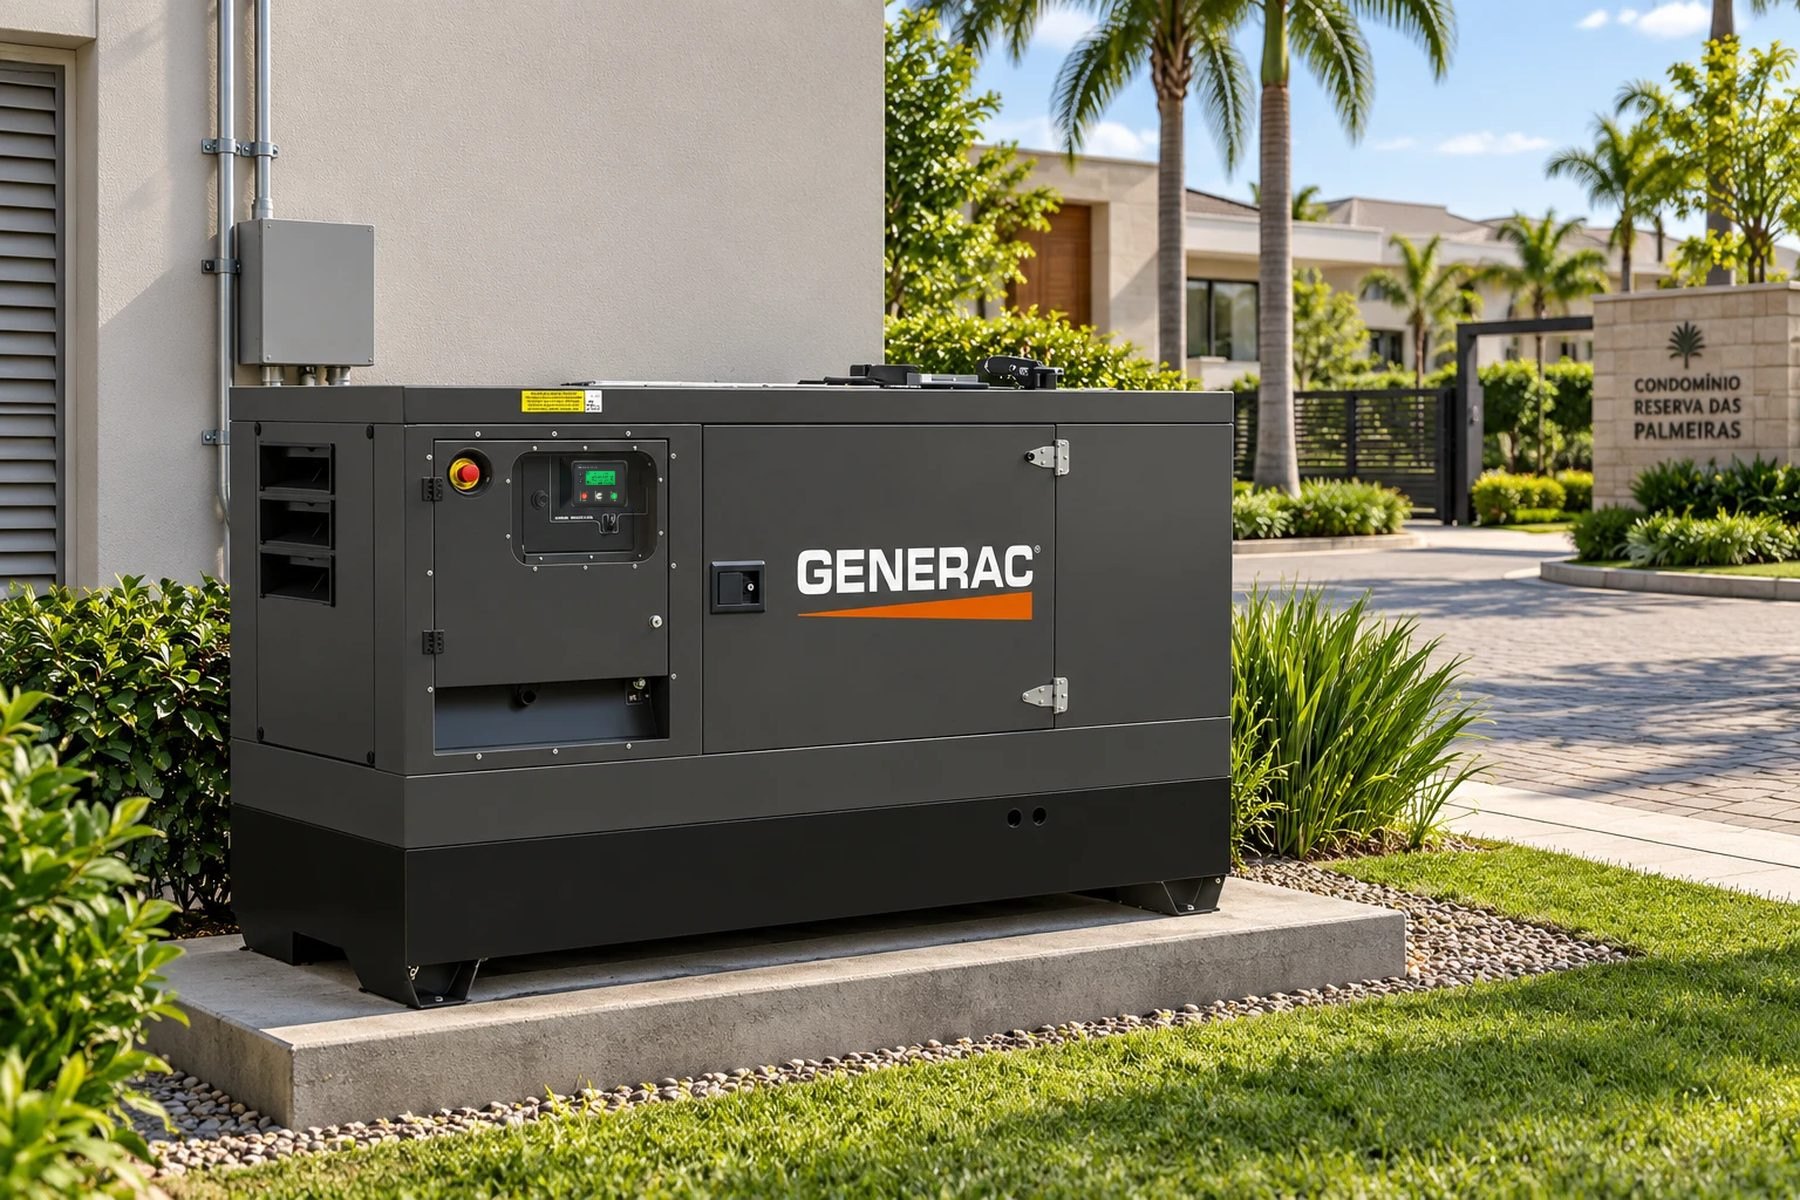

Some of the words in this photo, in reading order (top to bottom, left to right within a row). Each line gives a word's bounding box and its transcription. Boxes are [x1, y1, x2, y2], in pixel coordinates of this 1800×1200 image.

[1634, 373, 1741, 393] CONDOMÍNIO
[1634, 398, 1703, 415] RESERVA
[1709, 398, 1742, 414] DAS
[1634, 421, 1742, 440] PALMEIRAS
[797, 545, 1034, 595] GENERAC
